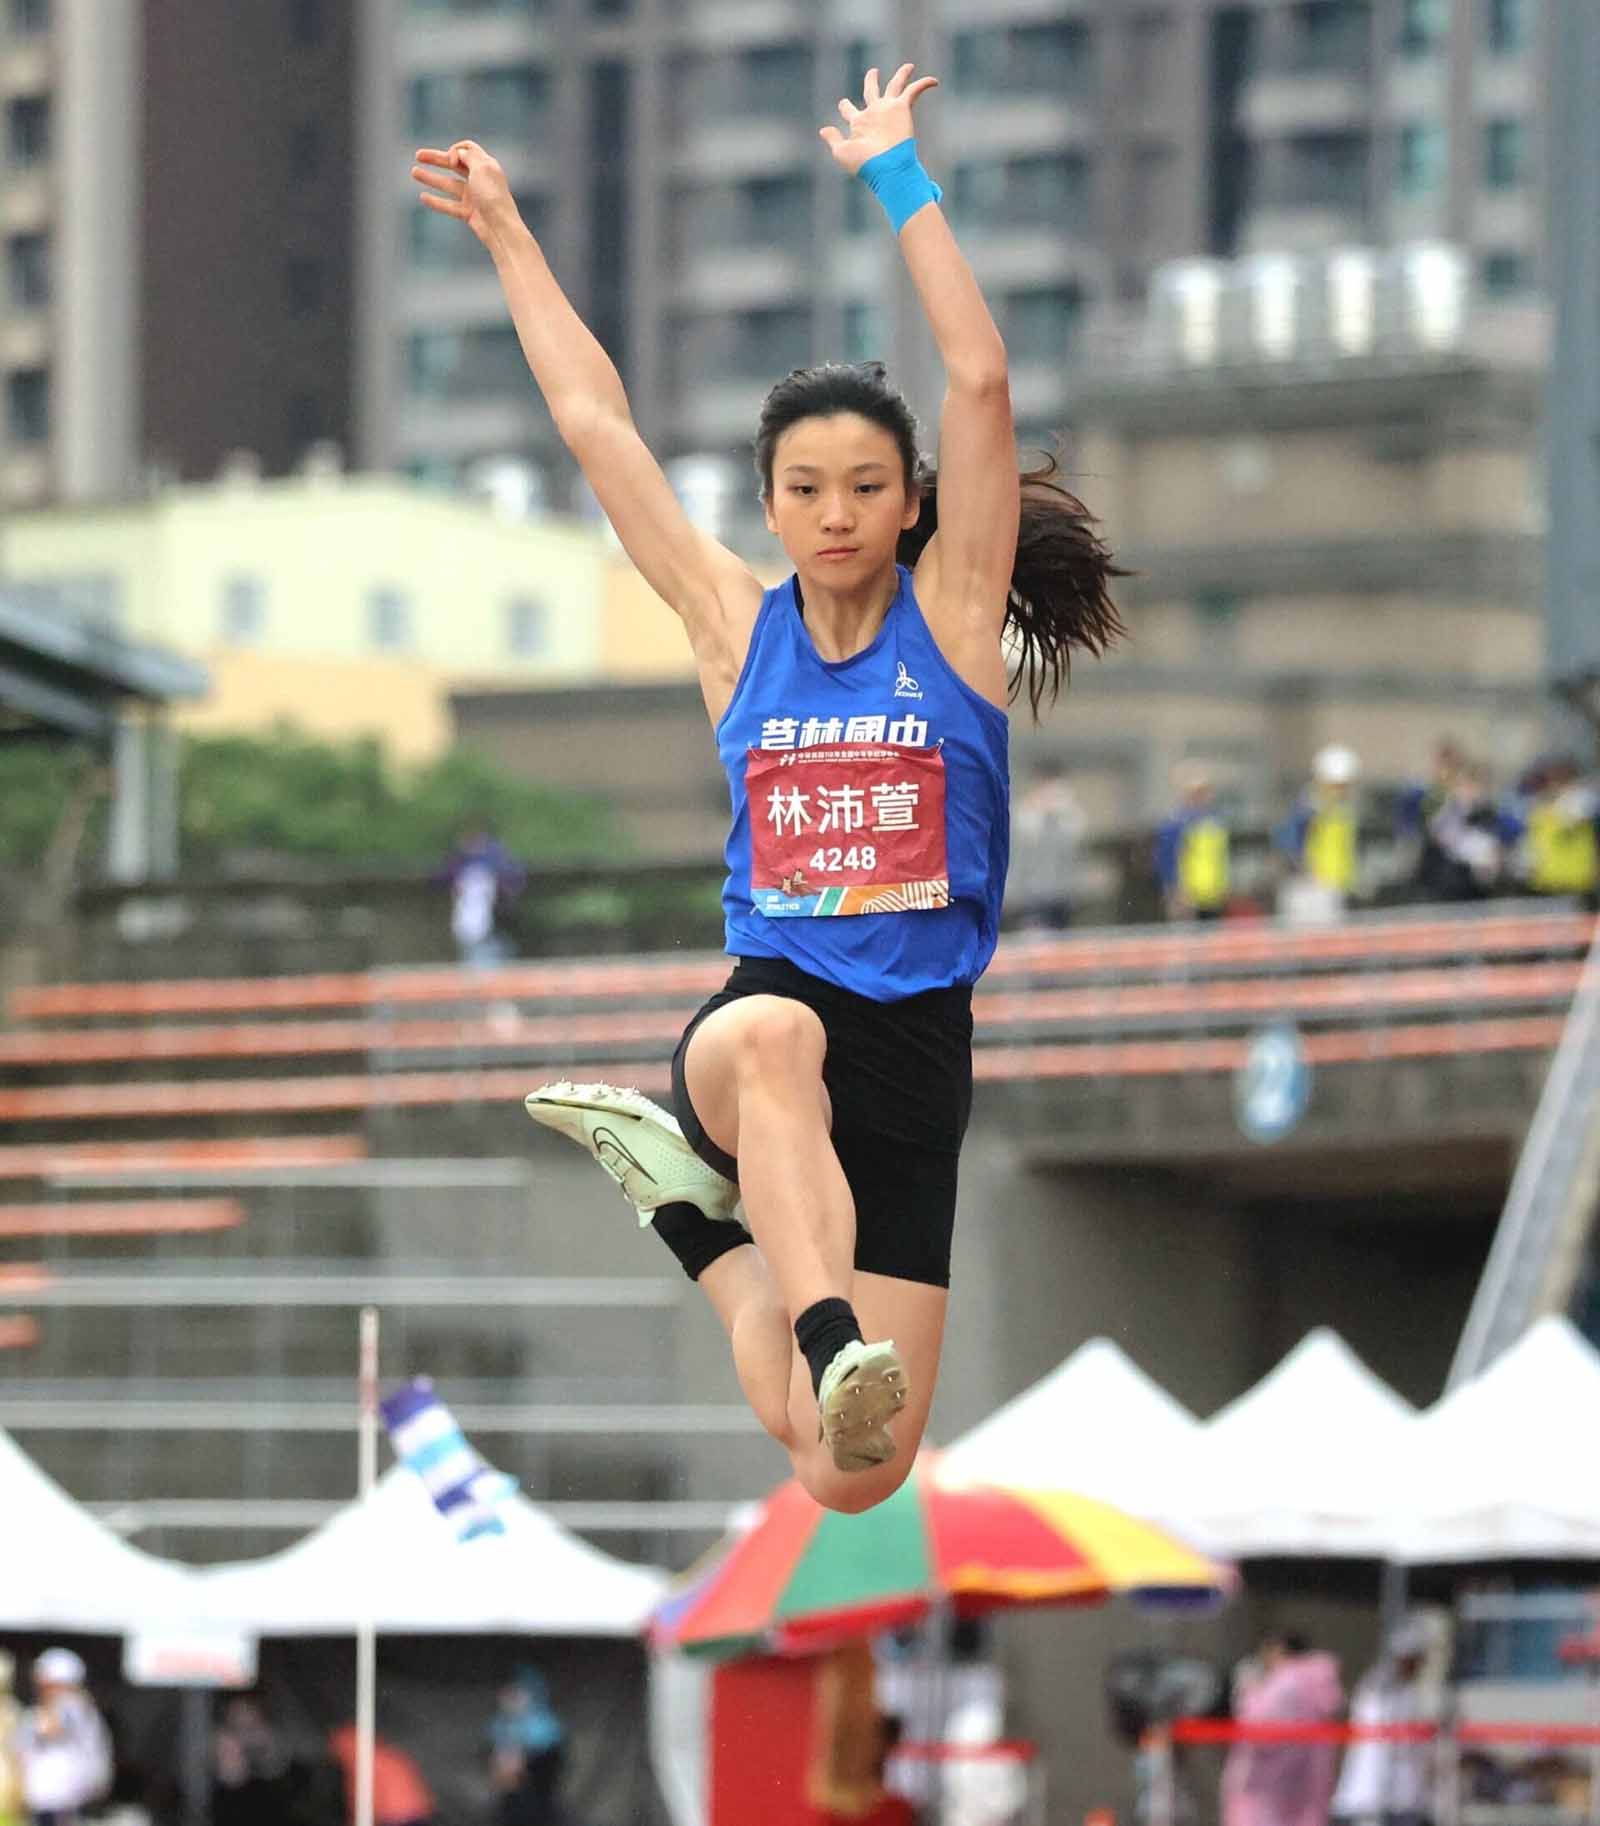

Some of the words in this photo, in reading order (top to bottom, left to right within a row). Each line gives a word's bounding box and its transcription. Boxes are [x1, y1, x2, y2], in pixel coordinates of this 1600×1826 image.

[767, 781, 919, 837] 林沛萱
[809, 846, 876, 872] 4248
